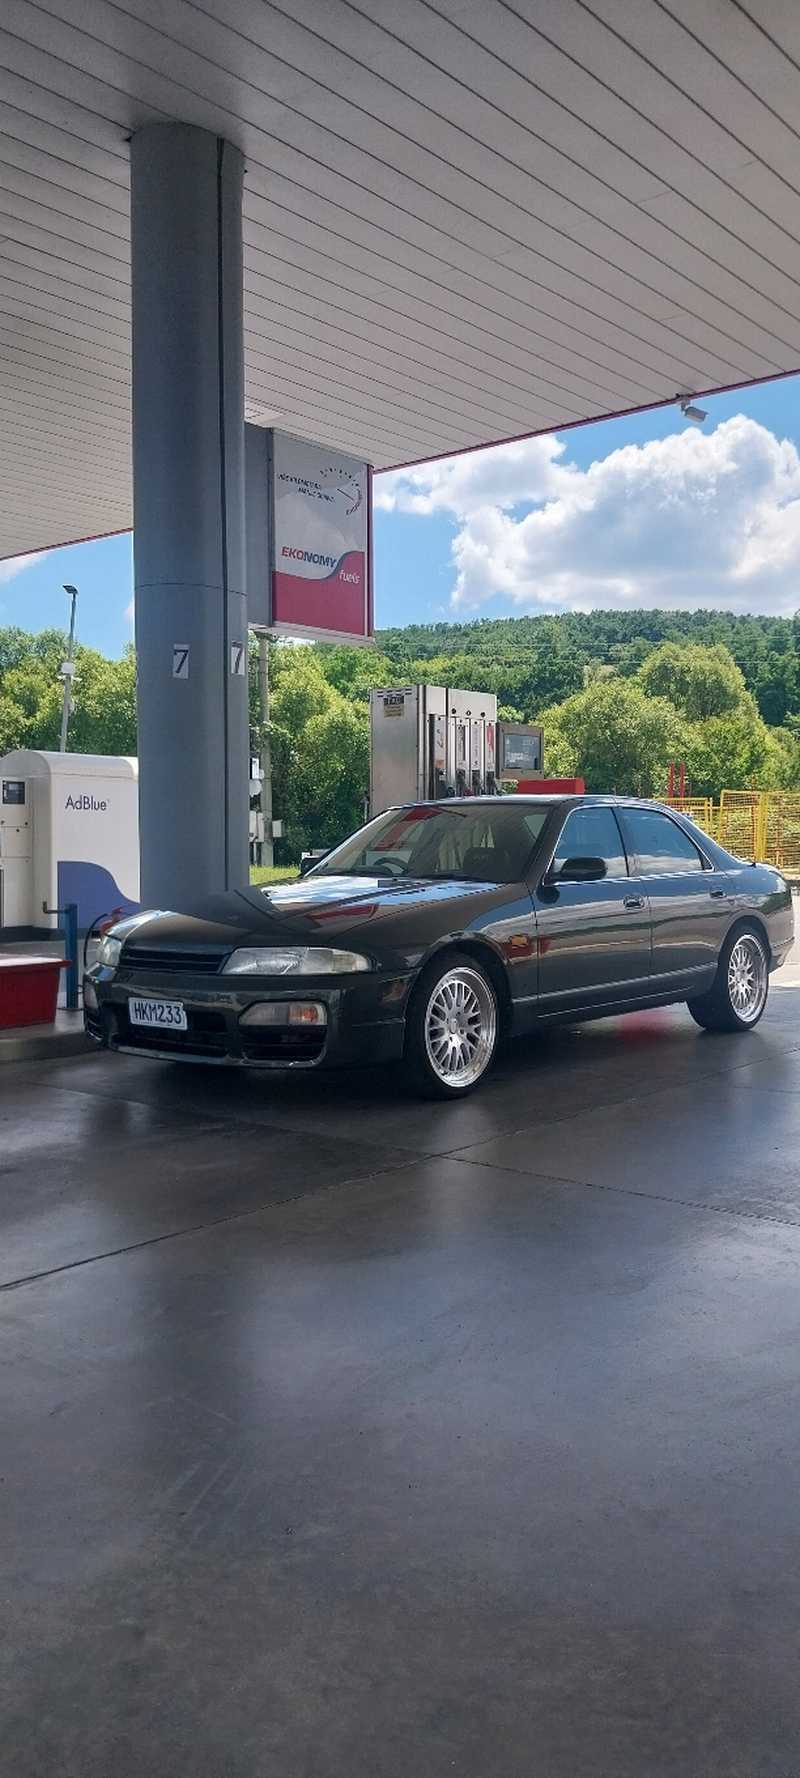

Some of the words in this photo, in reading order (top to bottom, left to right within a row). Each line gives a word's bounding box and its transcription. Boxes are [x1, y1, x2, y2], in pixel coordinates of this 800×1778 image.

[281, 546, 337, 568] EKONOMY
[339, 569, 361, 584] fuels
[174, 649, 189, 674] 7
[231, 641, 243, 674] 7
[65, 795, 107, 811] AdBlue
[134, 1001, 182, 1025] HKM233
